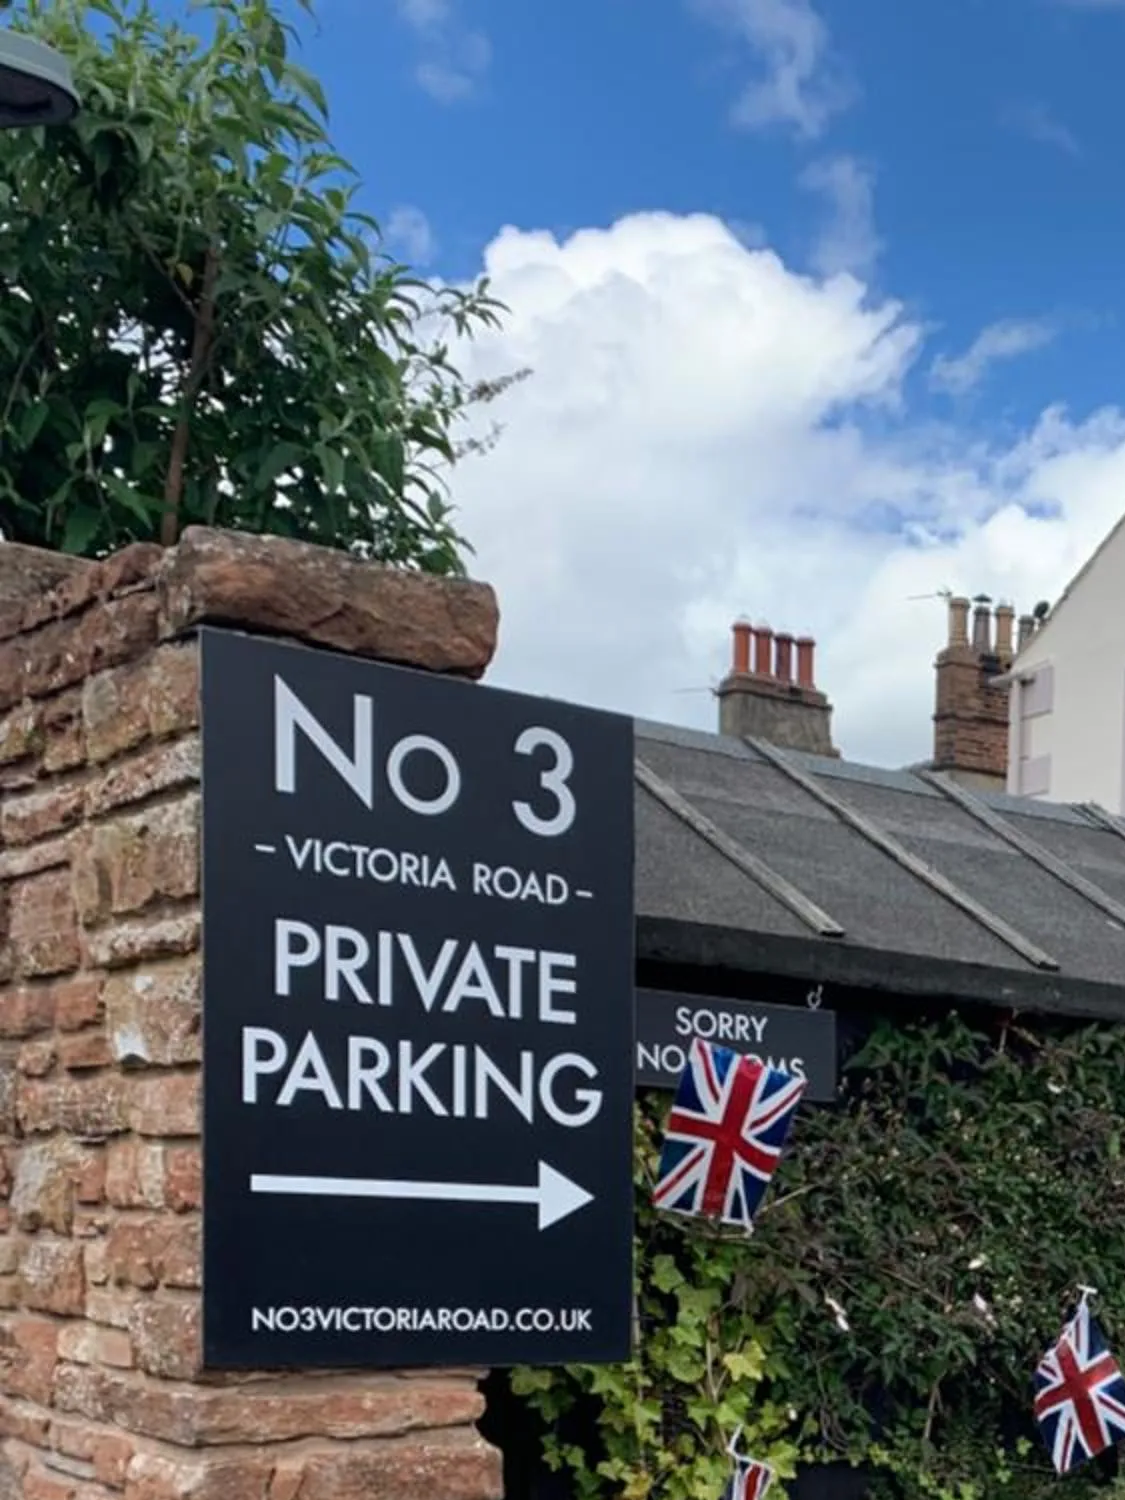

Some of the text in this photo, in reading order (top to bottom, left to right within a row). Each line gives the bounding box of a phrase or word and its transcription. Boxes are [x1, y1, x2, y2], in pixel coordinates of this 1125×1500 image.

[274, 672, 577, 838] No 3
[275, 918, 577, 1025] PRIVATE
[636, 1041, 686, 1074] NO
[675, 1006, 768, 1043] SORRY
[242, 1026, 604, 1128] PARKING
[252, 1305, 593, 1333] NO3VICTORIAROAD.CO.UK
